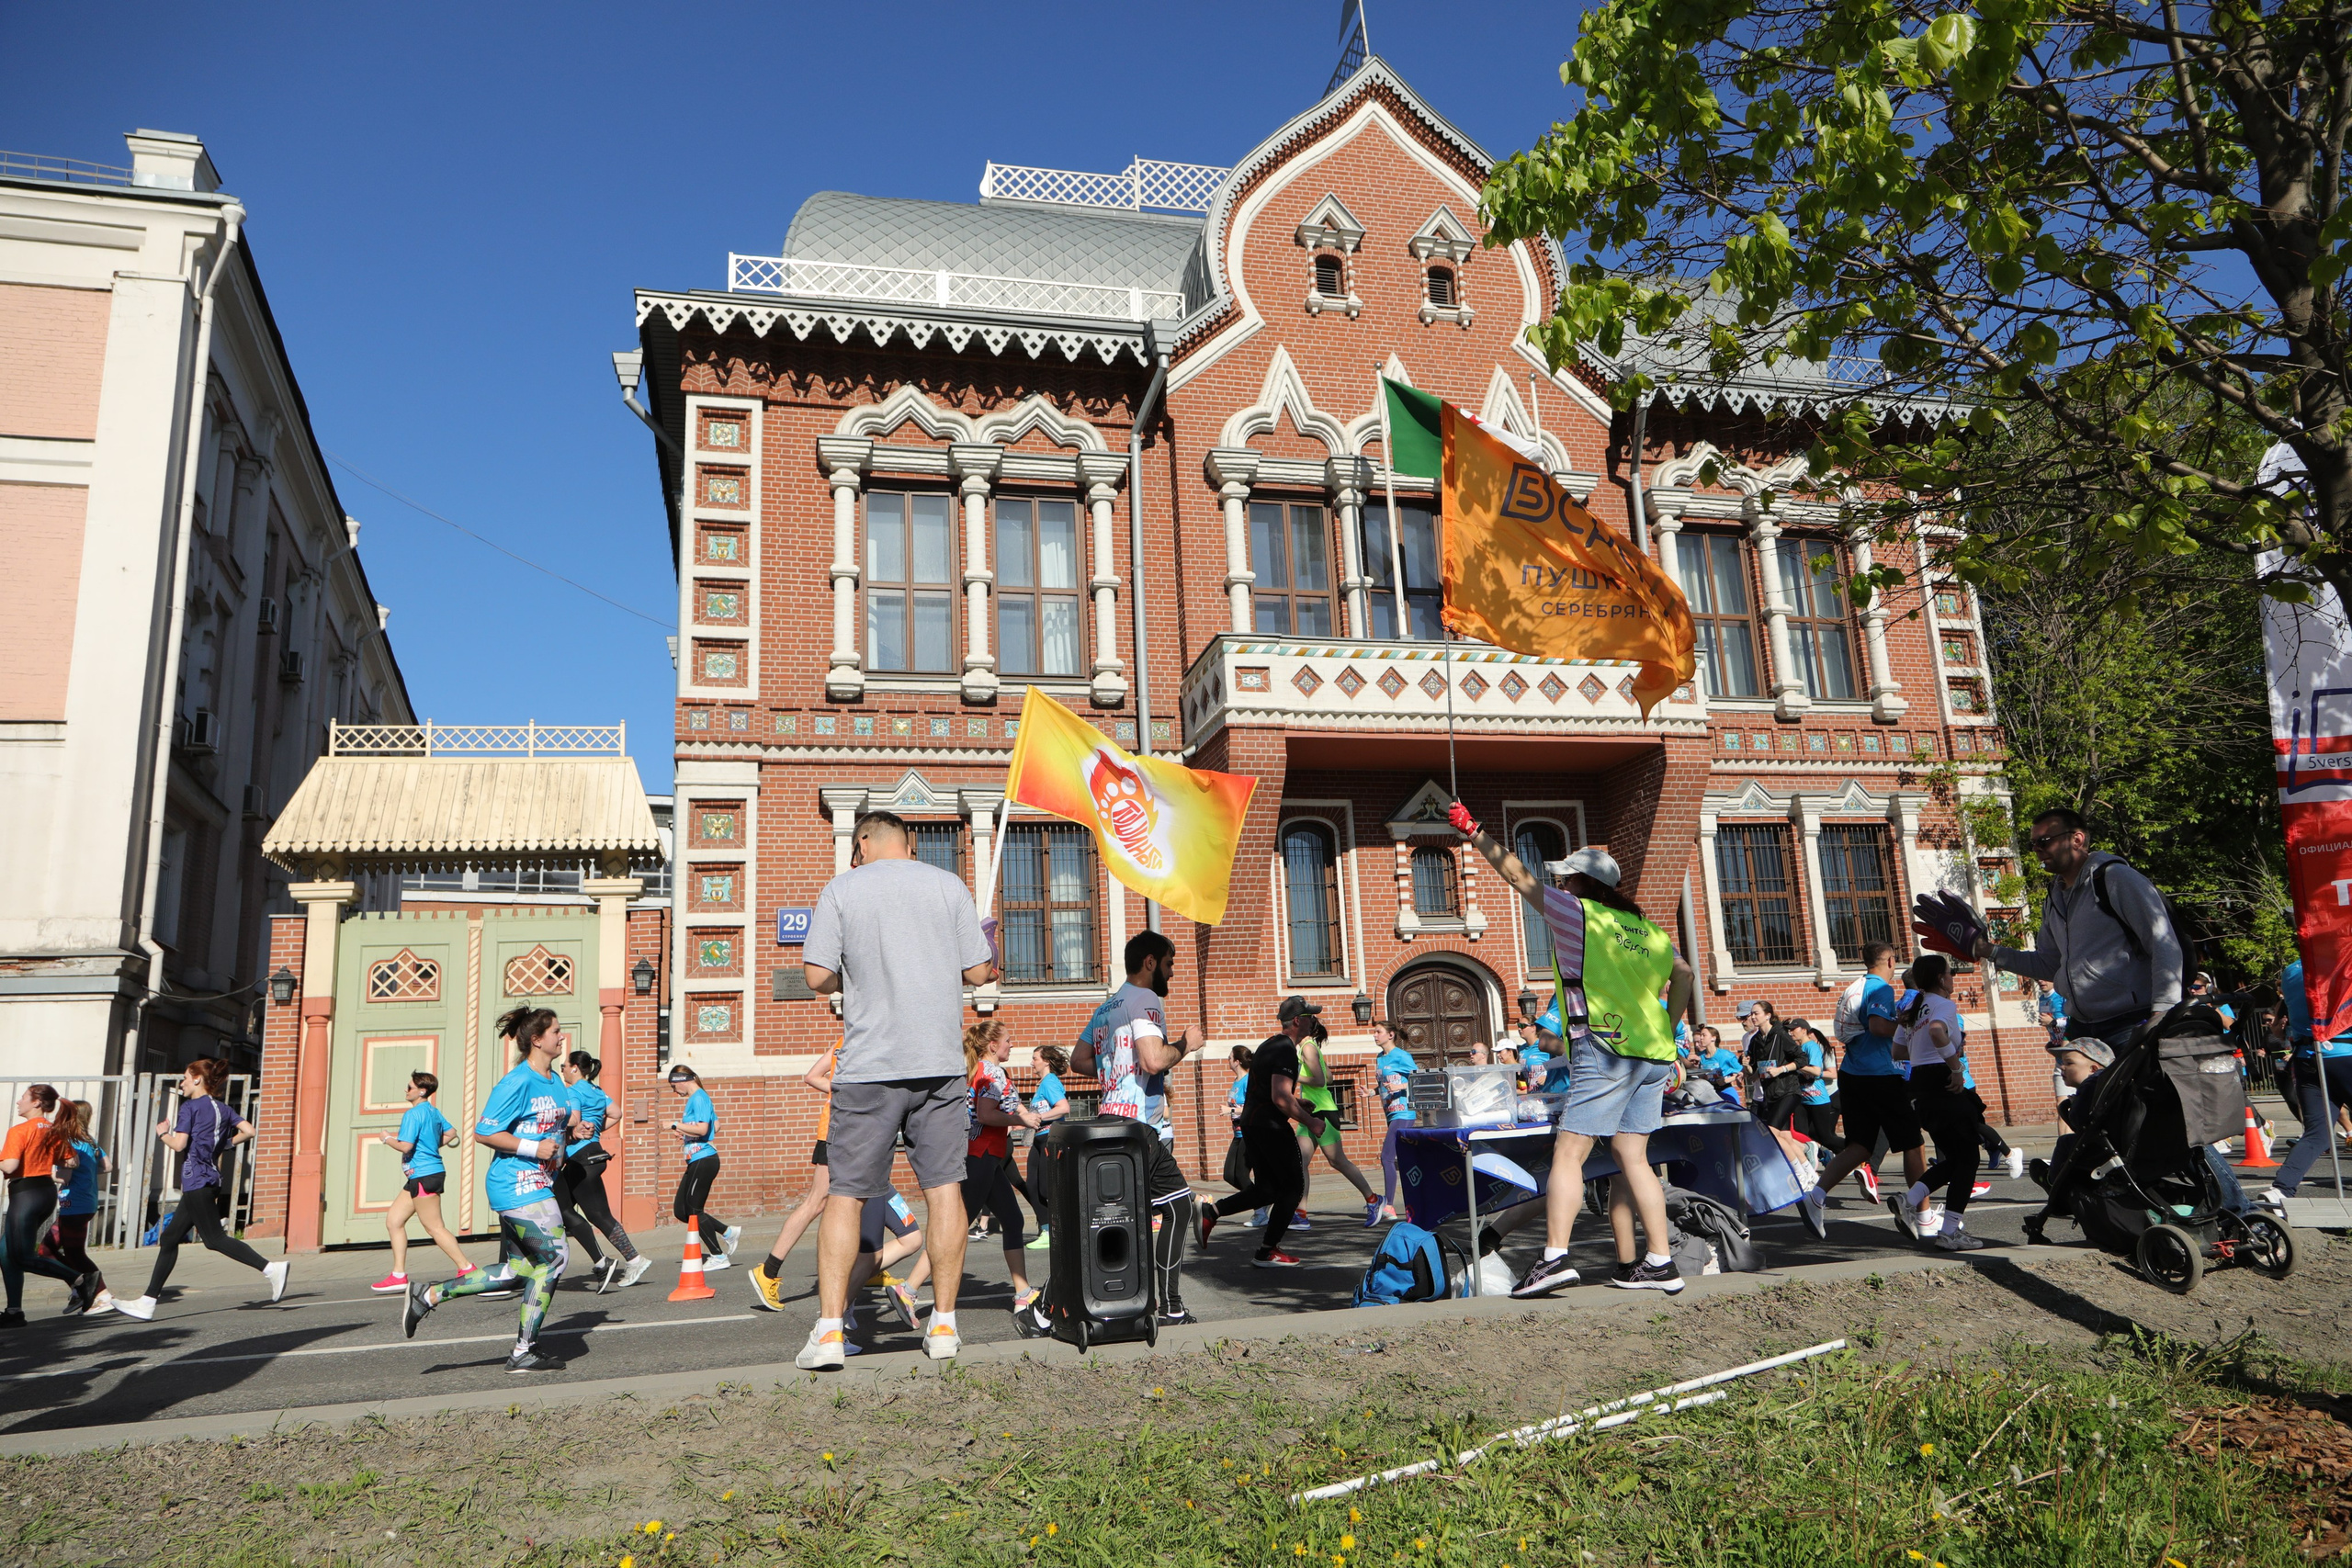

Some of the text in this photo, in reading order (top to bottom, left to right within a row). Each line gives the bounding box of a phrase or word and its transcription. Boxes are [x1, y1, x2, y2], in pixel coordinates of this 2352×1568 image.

[1521, 564, 1631, 592] ПУШК
[1541, 602, 1652, 620] СЕРЕБРЯН
[2308, 755, 2352, 770] 5vers
[783, 913, 808, 931] 29
[530, 1095, 558, 1112] 2024
